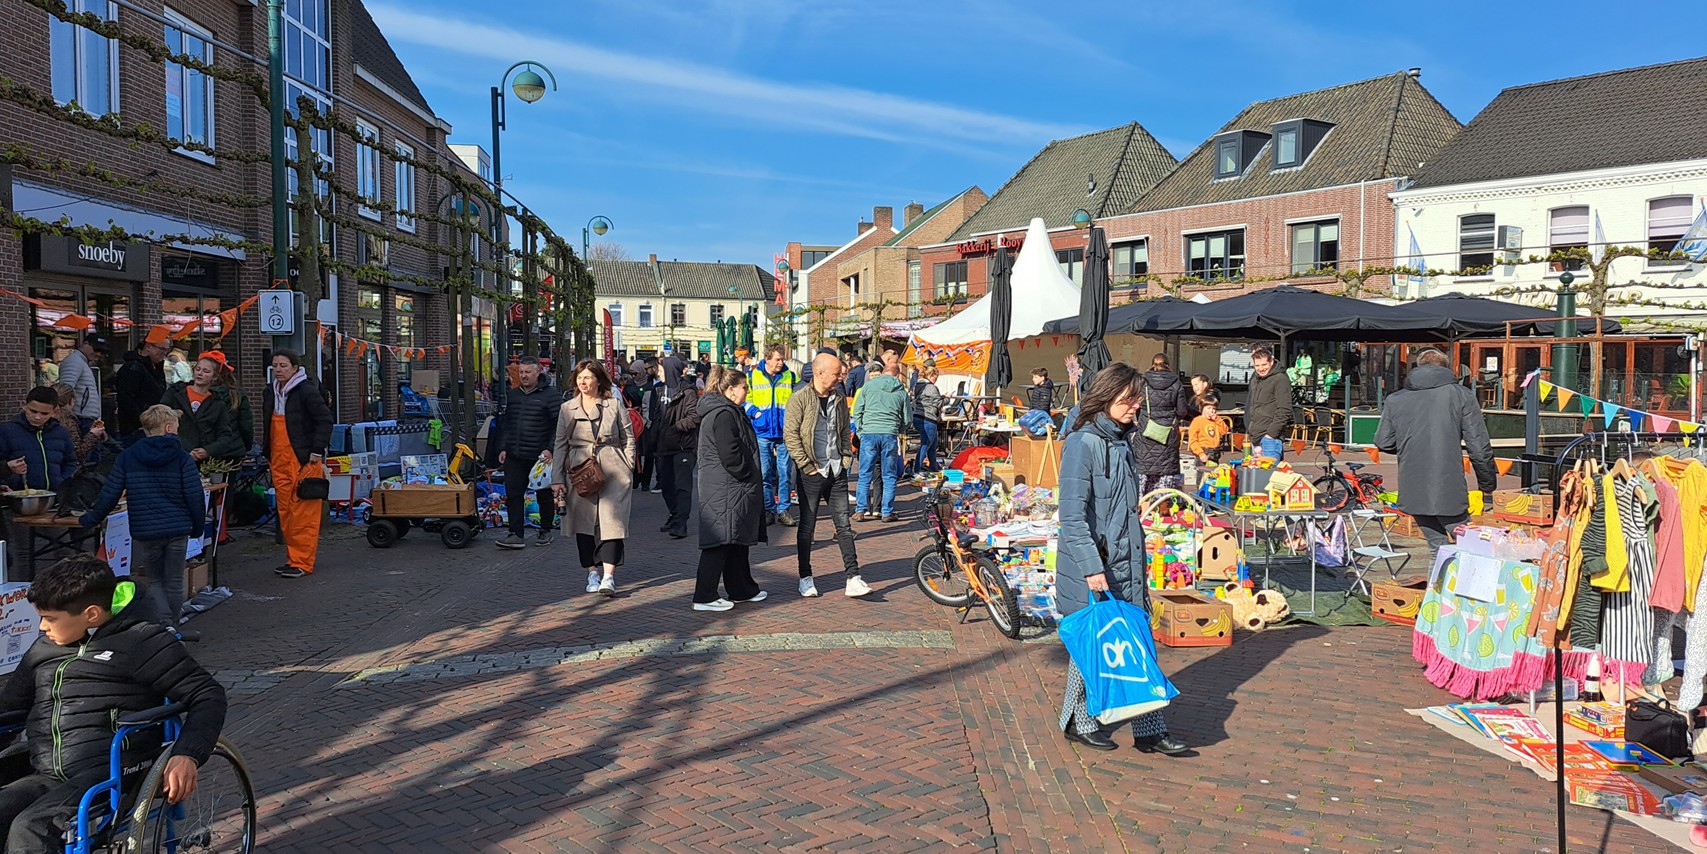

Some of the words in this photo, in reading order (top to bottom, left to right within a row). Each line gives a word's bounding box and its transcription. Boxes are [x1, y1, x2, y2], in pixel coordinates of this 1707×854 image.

[956, 241, 990, 255] Bakkerij
[774, 253, 785, 305] HEMA
[271, 318, 282, 326] 12
